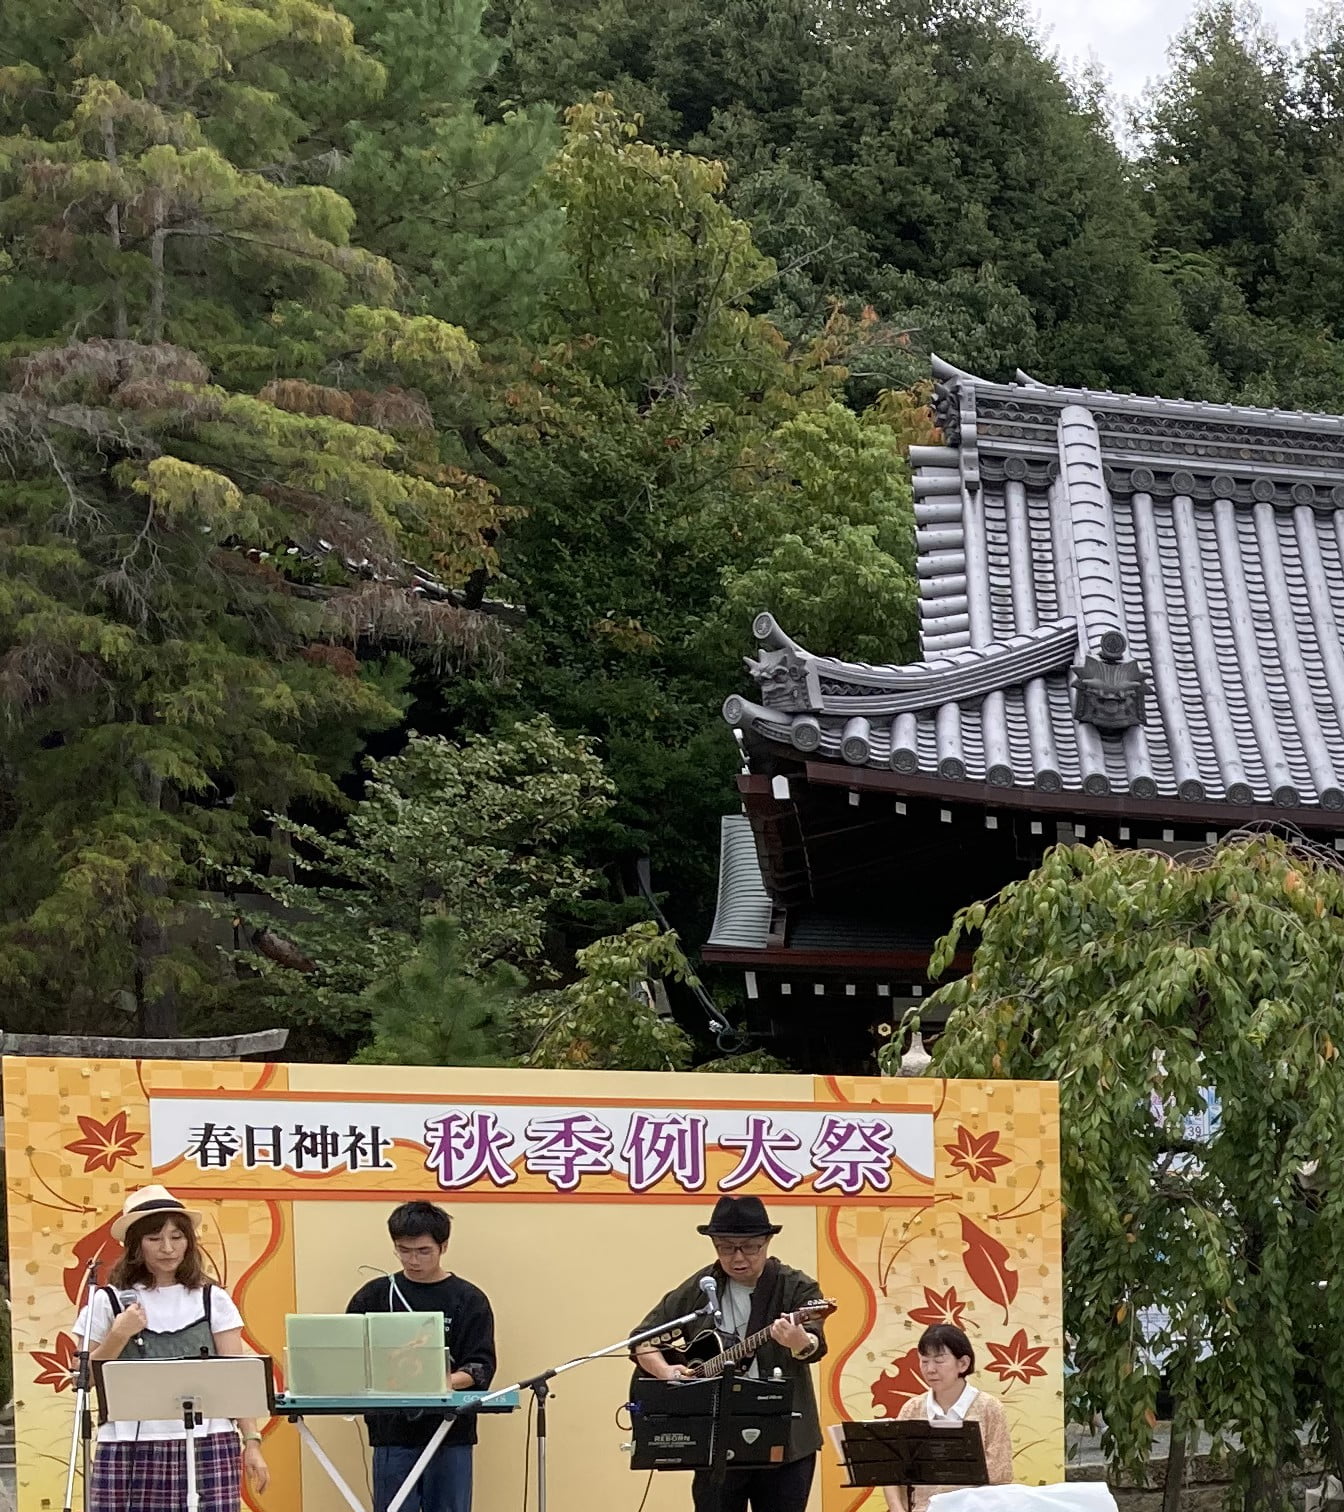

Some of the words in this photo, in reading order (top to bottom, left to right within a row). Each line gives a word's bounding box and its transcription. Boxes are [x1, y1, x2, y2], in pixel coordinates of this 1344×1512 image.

[187, 1122, 396, 1170] 春日神社
[424, 1110, 895, 1193] 秋季例大祭
